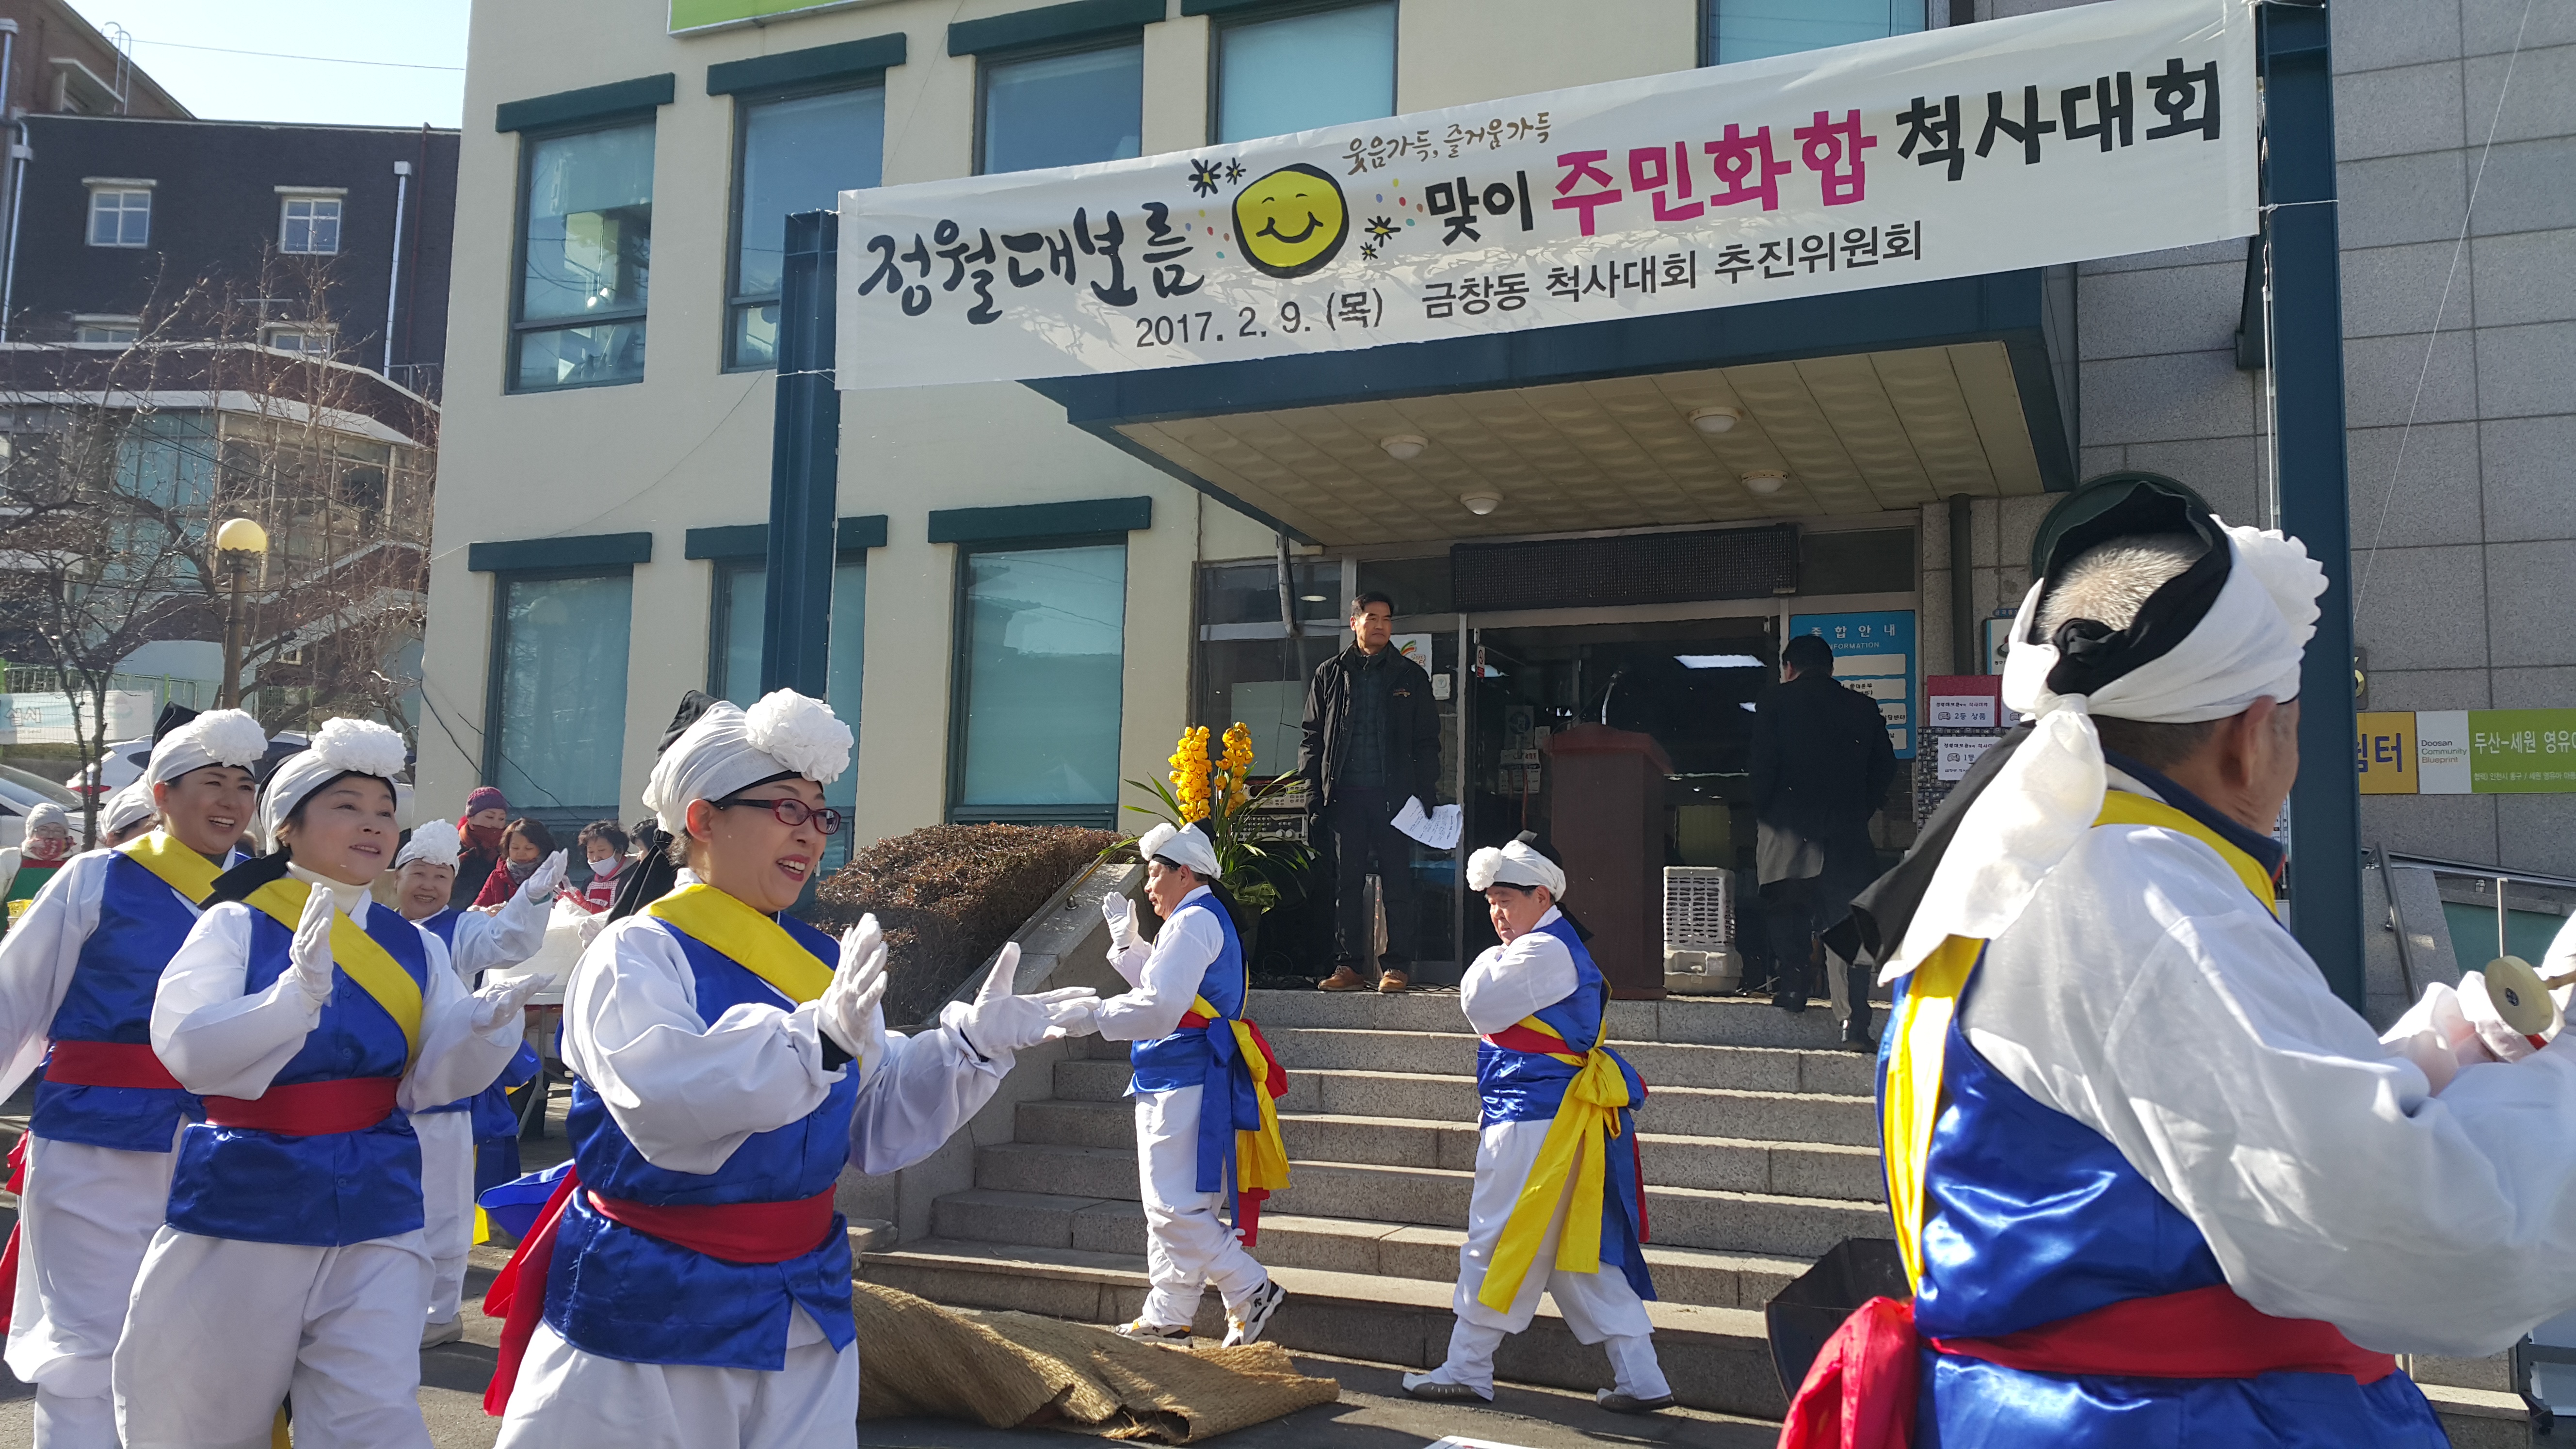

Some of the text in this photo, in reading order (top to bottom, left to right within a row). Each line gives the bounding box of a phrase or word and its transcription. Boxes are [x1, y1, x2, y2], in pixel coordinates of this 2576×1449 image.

[1342, 112, 1551, 175] 웃음가득, 즐거움가득
[858, 57, 2221, 324] 정월대보름 맞이 주민화합 척사대회
[1136, 219, 1922, 348] 2017. 2. 9. (목) 금창동 척사대회 추진위원회
[2421, 747, 2467, 756] Community
[2421, 756, 2459, 764] Blueprint
[2474, 730, 2536, 755] 두산-세원
